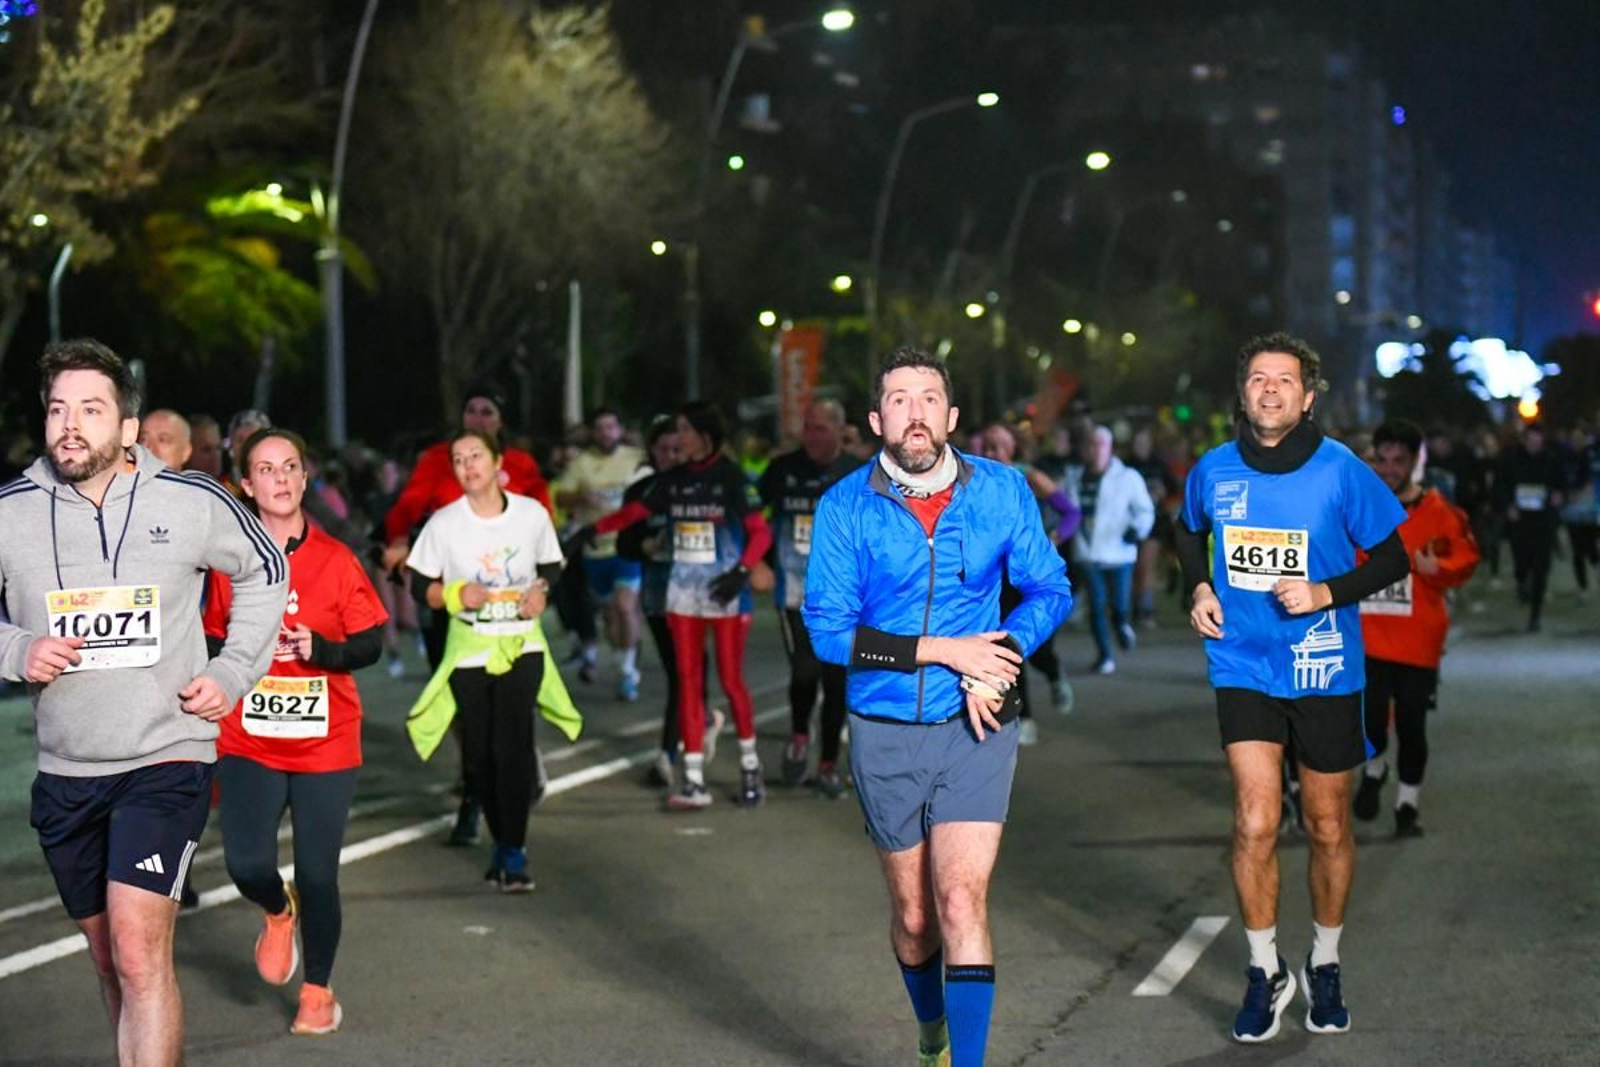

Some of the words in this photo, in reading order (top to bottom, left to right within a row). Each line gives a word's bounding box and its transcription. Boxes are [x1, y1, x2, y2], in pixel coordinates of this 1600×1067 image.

[1231, 545, 1299, 569] 4618
[54, 611, 151, 638] 10071
[860, 652, 895, 662] KIPSTA
[251, 693, 320, 714] 9627
